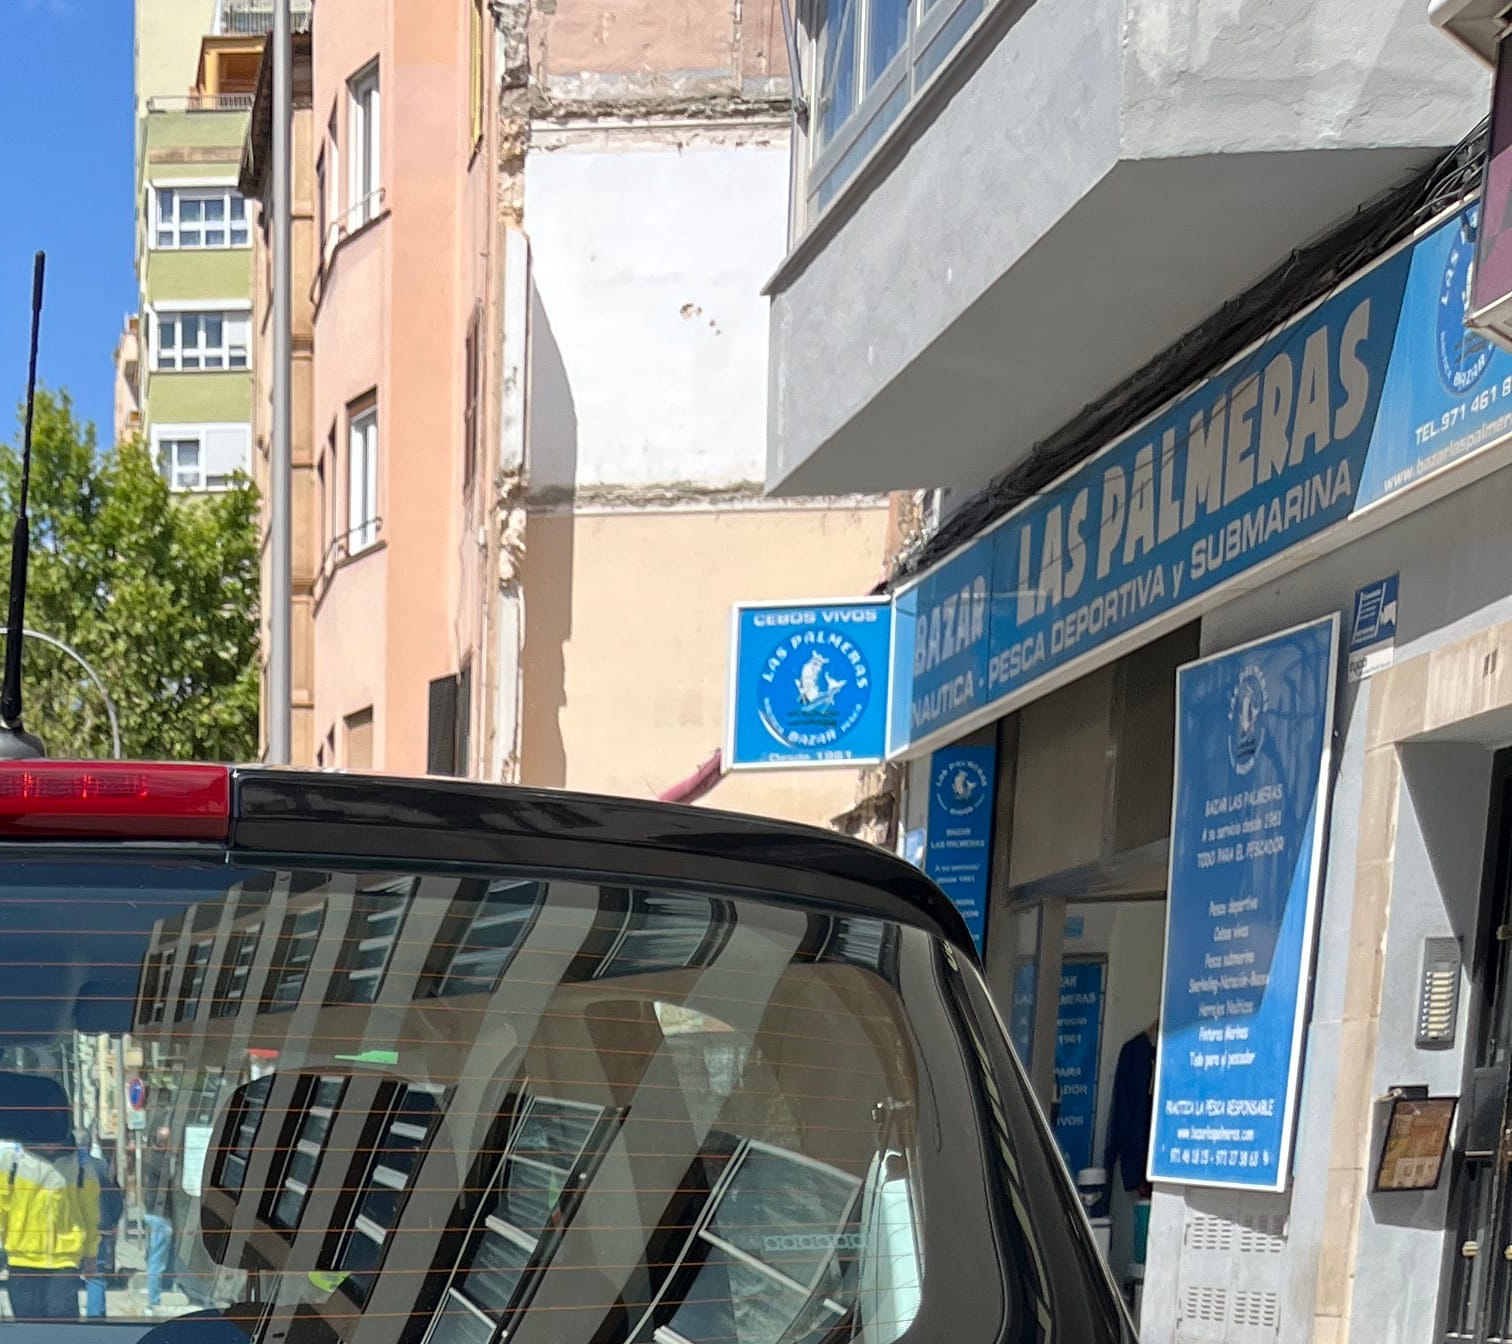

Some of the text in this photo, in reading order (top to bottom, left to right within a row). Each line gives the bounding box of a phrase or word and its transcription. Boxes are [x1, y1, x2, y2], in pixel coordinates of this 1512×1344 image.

[1453, 353, 1486, 390] BAZAR
[1470, 384, 1498, 414] 461
[913, 298, 1371, 678] BAZAR LAS PALMERAS
[912, 458, 1352, 728] NAUTICA PESCA DEPORTIVA y SUBMARINA
[753, 609, 878, 627] CEBOS VIVOS
[762, 630, 869, 689] LAS PALMERAS
[788, 728, 837, 747] BAZAR
[1204, 784, 1284, 817] BAZAR LAS PALMERAS
[1196, 850, 1216, 869] TODO
[1216, 847, 1234, 865] PARA
[1245, 835, 1285, 860] PESCADOR
